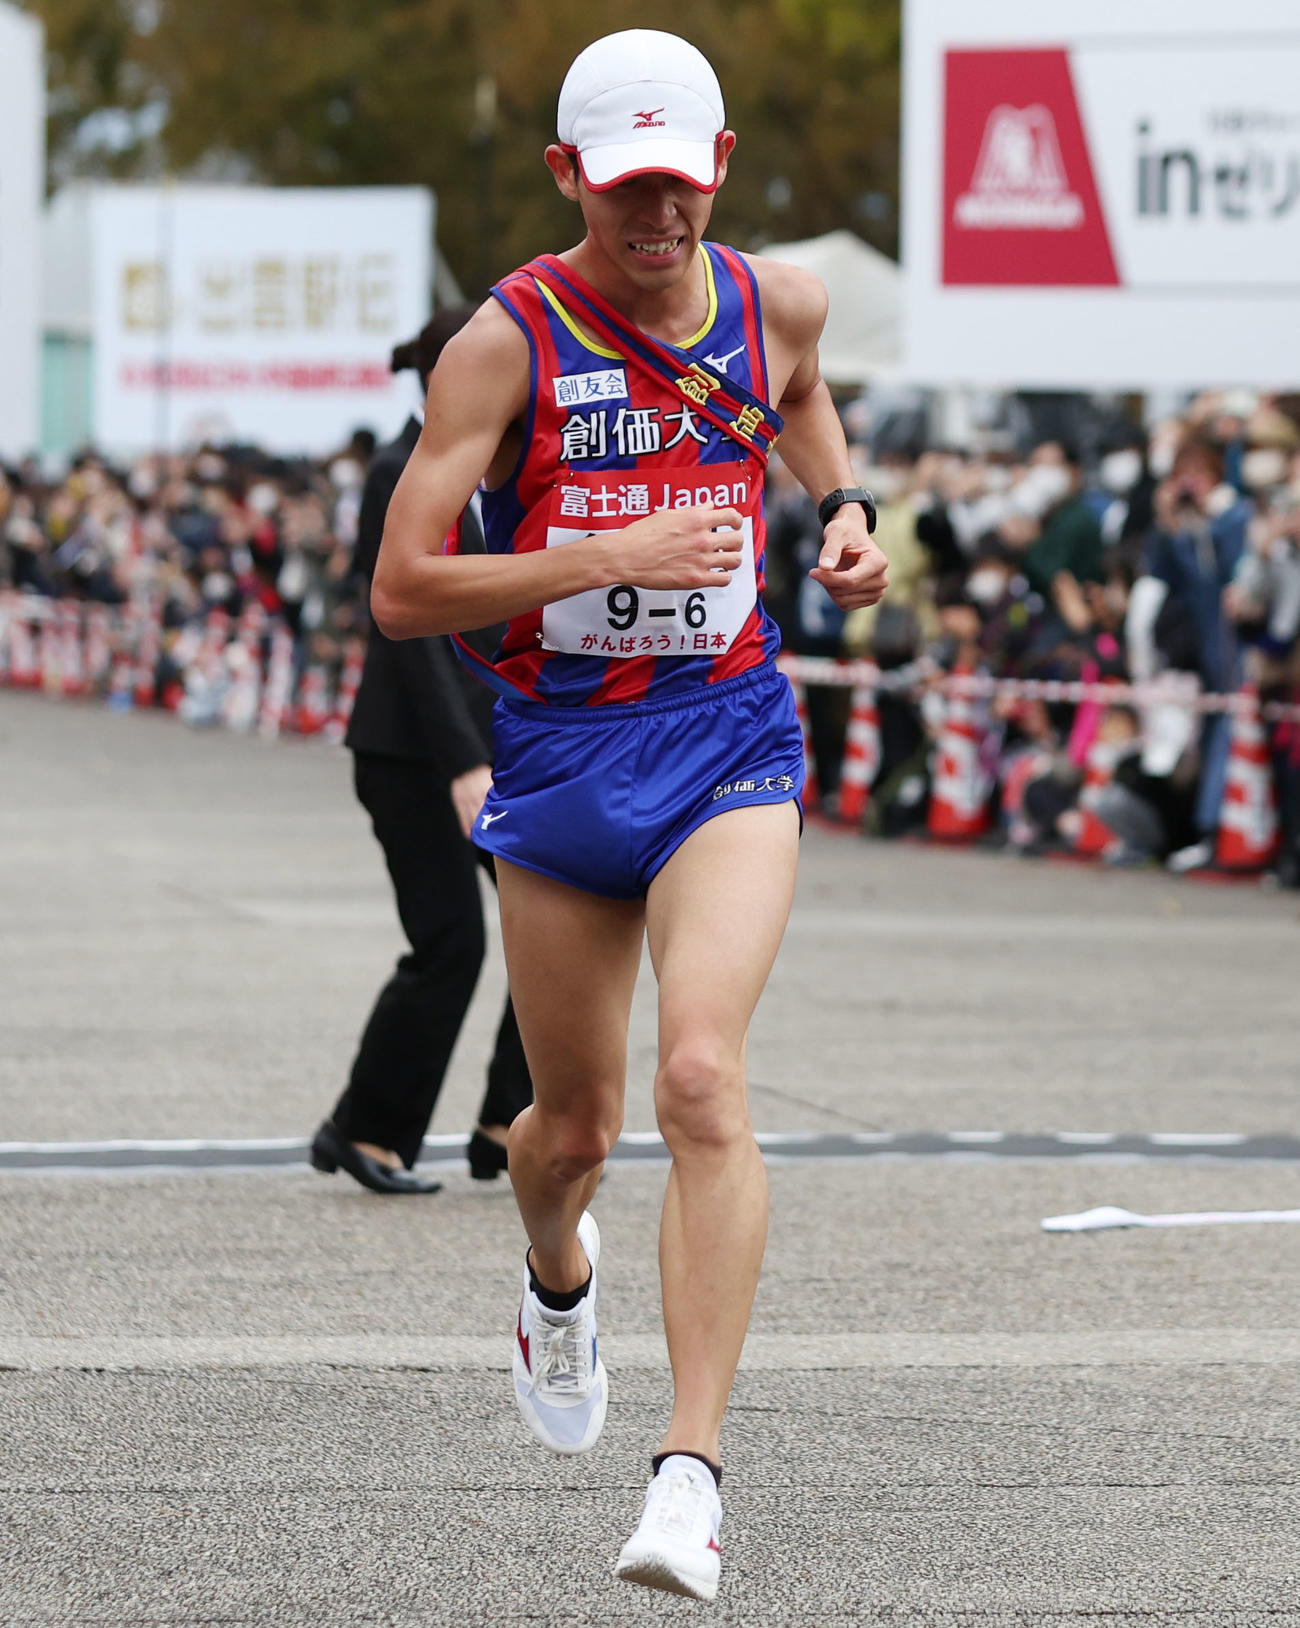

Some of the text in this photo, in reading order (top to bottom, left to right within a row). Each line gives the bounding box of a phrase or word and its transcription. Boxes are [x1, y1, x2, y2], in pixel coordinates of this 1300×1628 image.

[556, 374, 625, 403] 創友会
[558, 403, 734, 462] 創価大
